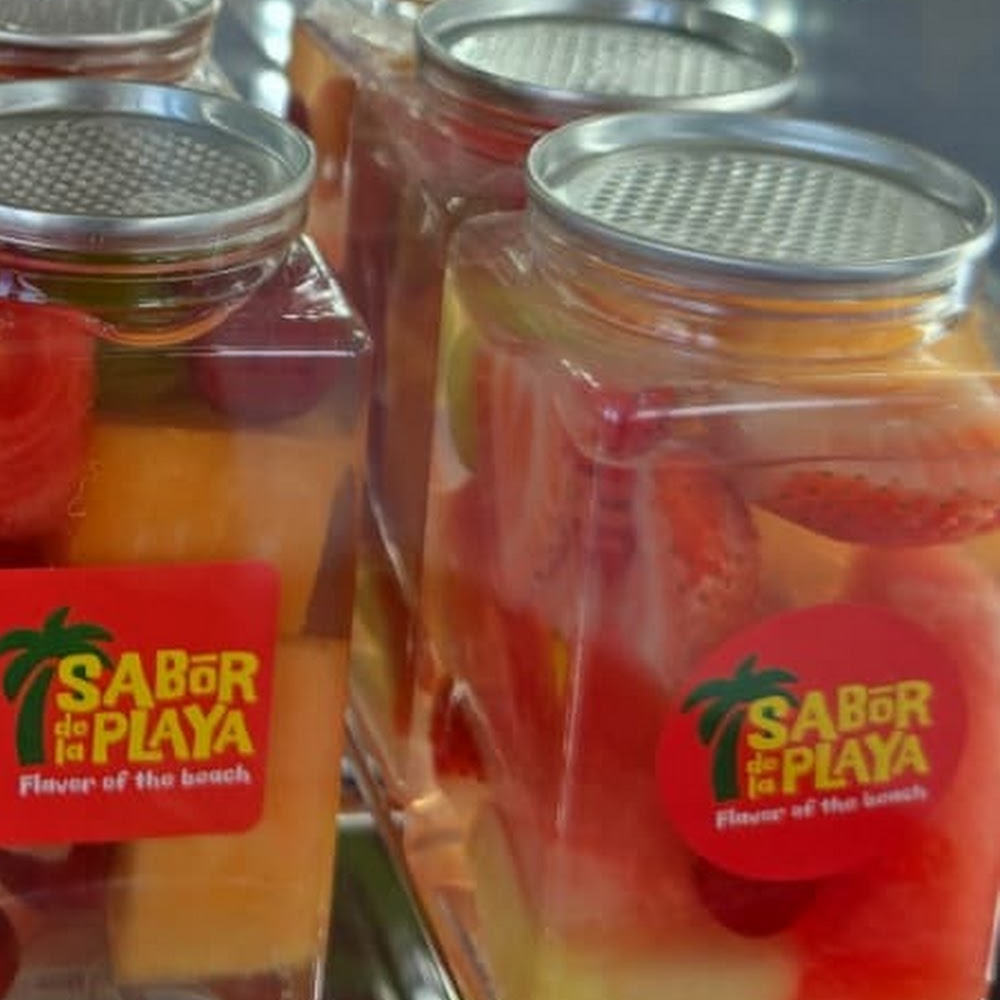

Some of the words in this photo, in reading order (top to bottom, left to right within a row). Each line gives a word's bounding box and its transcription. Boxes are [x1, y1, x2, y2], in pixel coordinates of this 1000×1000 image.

[55, 714, 88, 738] de
[55, 738, 84, 766] la
[92, 704, 255, 764] PLAYA
[18, 773, 96, 797] Flavor
[103, 771, 128, 791] of
[135, 769, 174, 790] the
[181, 764, 252, 786] beach
[782, 731, 930, 795] PLAYA
